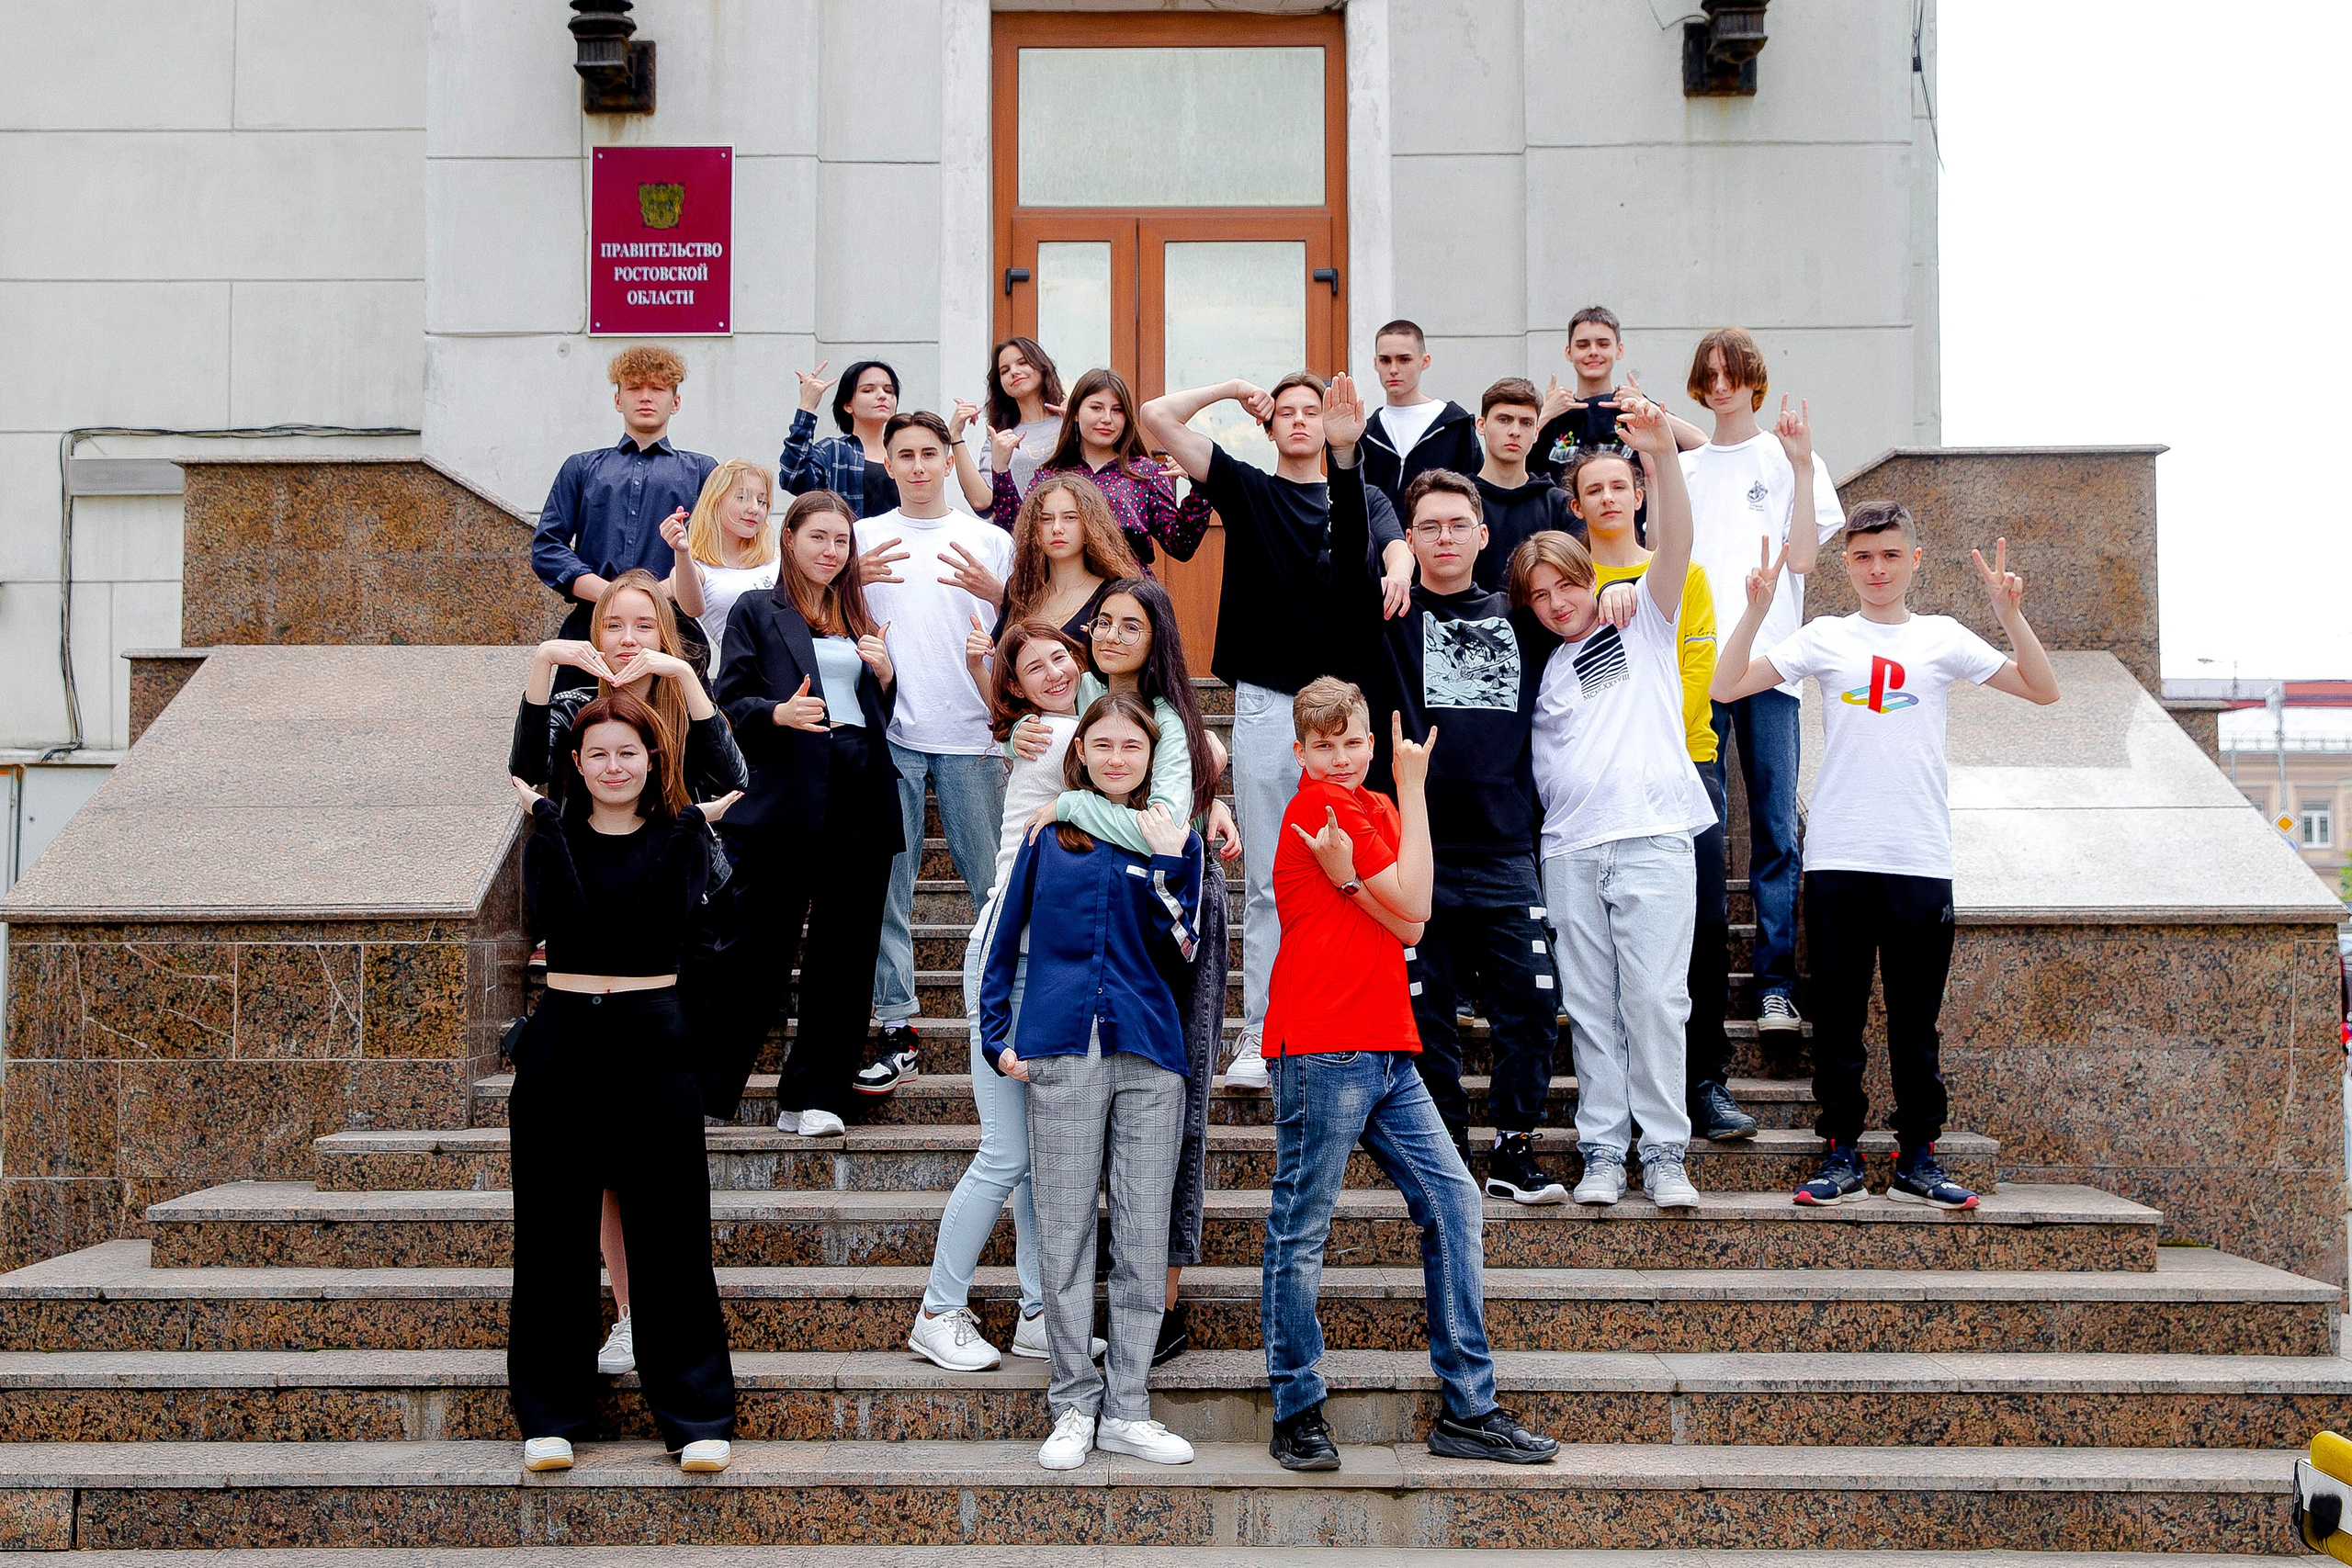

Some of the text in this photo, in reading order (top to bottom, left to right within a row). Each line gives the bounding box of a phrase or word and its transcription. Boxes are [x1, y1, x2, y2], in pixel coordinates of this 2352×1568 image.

[600, 243, 723, 258] ПРАВИТЕЛЬСТВО
[614, 263, 708, 282] РОСТОВСКОЙ
[627, 289, 695, 305] ОБЛАСТИ
